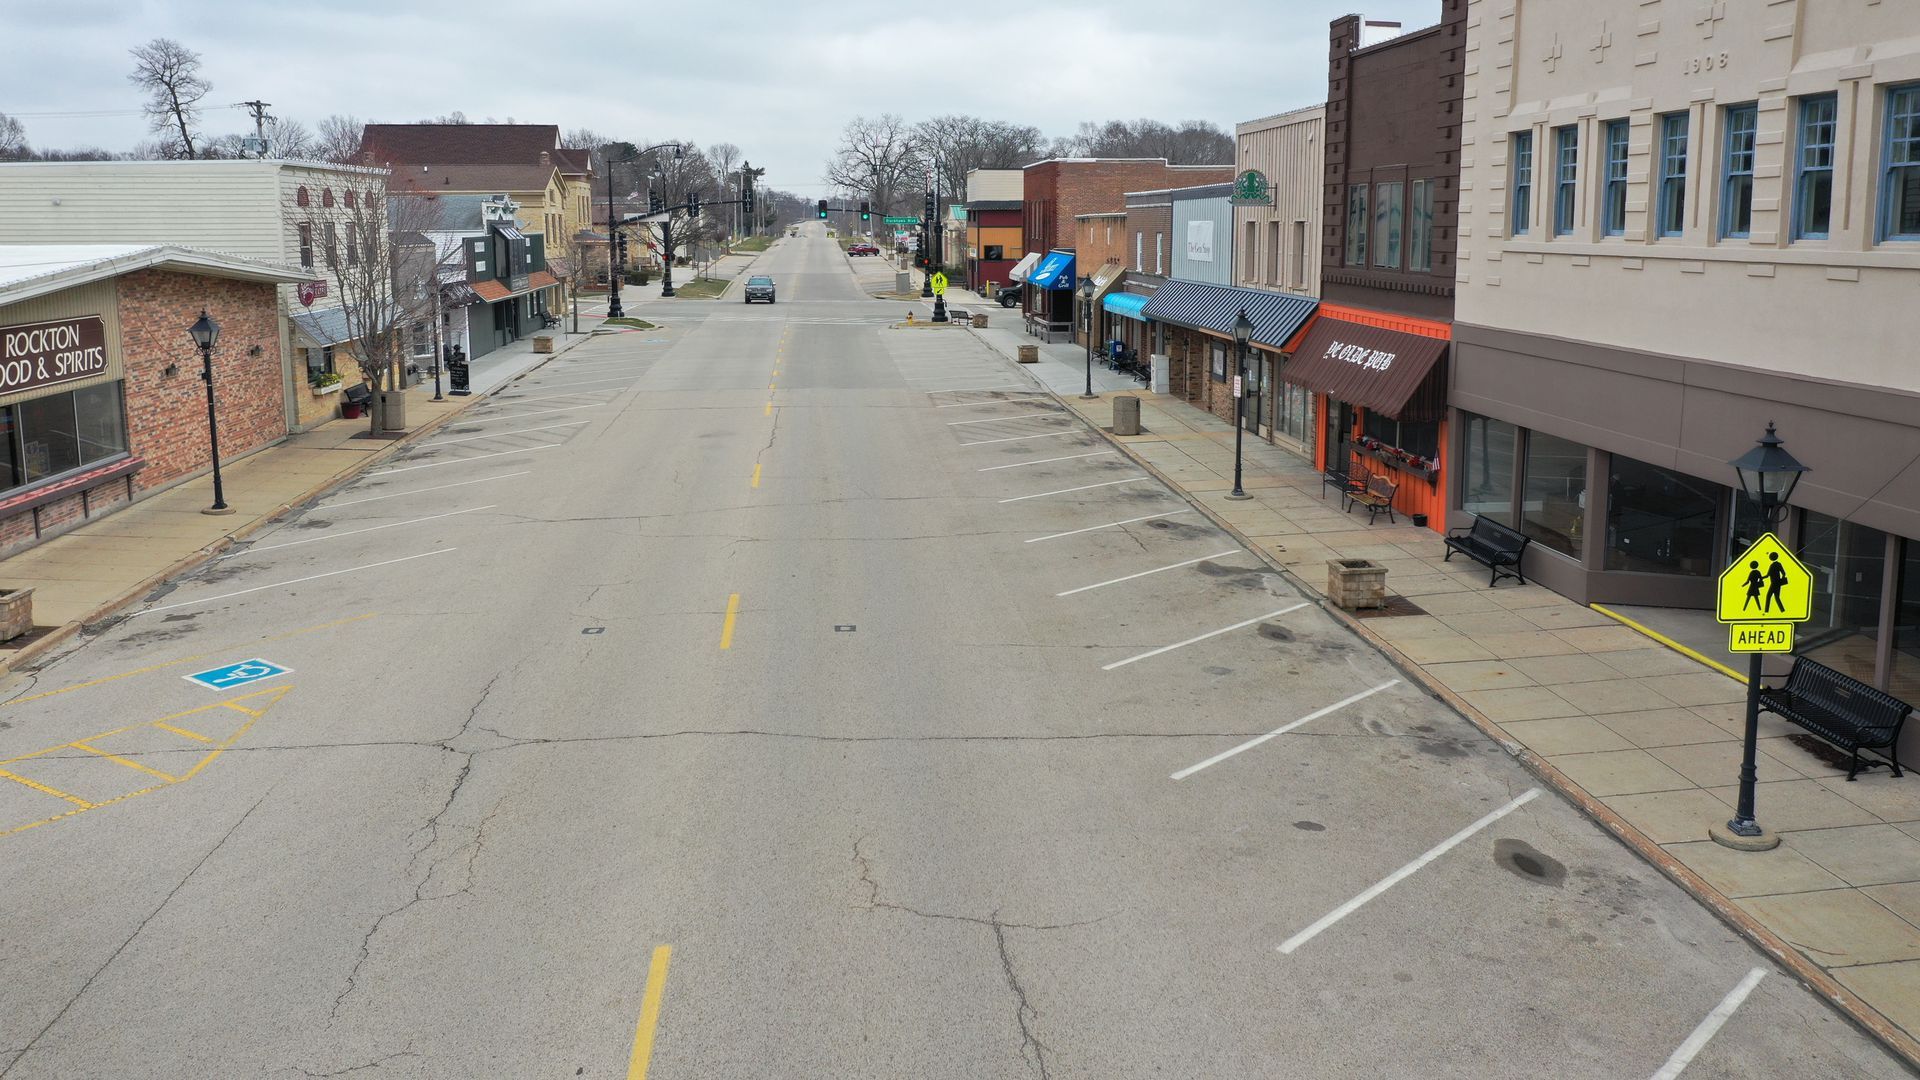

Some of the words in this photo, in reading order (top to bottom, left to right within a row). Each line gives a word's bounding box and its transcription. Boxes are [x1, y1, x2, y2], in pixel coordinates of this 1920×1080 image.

[1683, 51, 1729, 75] 1908
[5, 324, 80, 358] ROCKTON
[37, 356, 50, 380] &
[55, 346, 103, 377] SPIRITS
[1738, 630, 1785, 644] AHEAD
